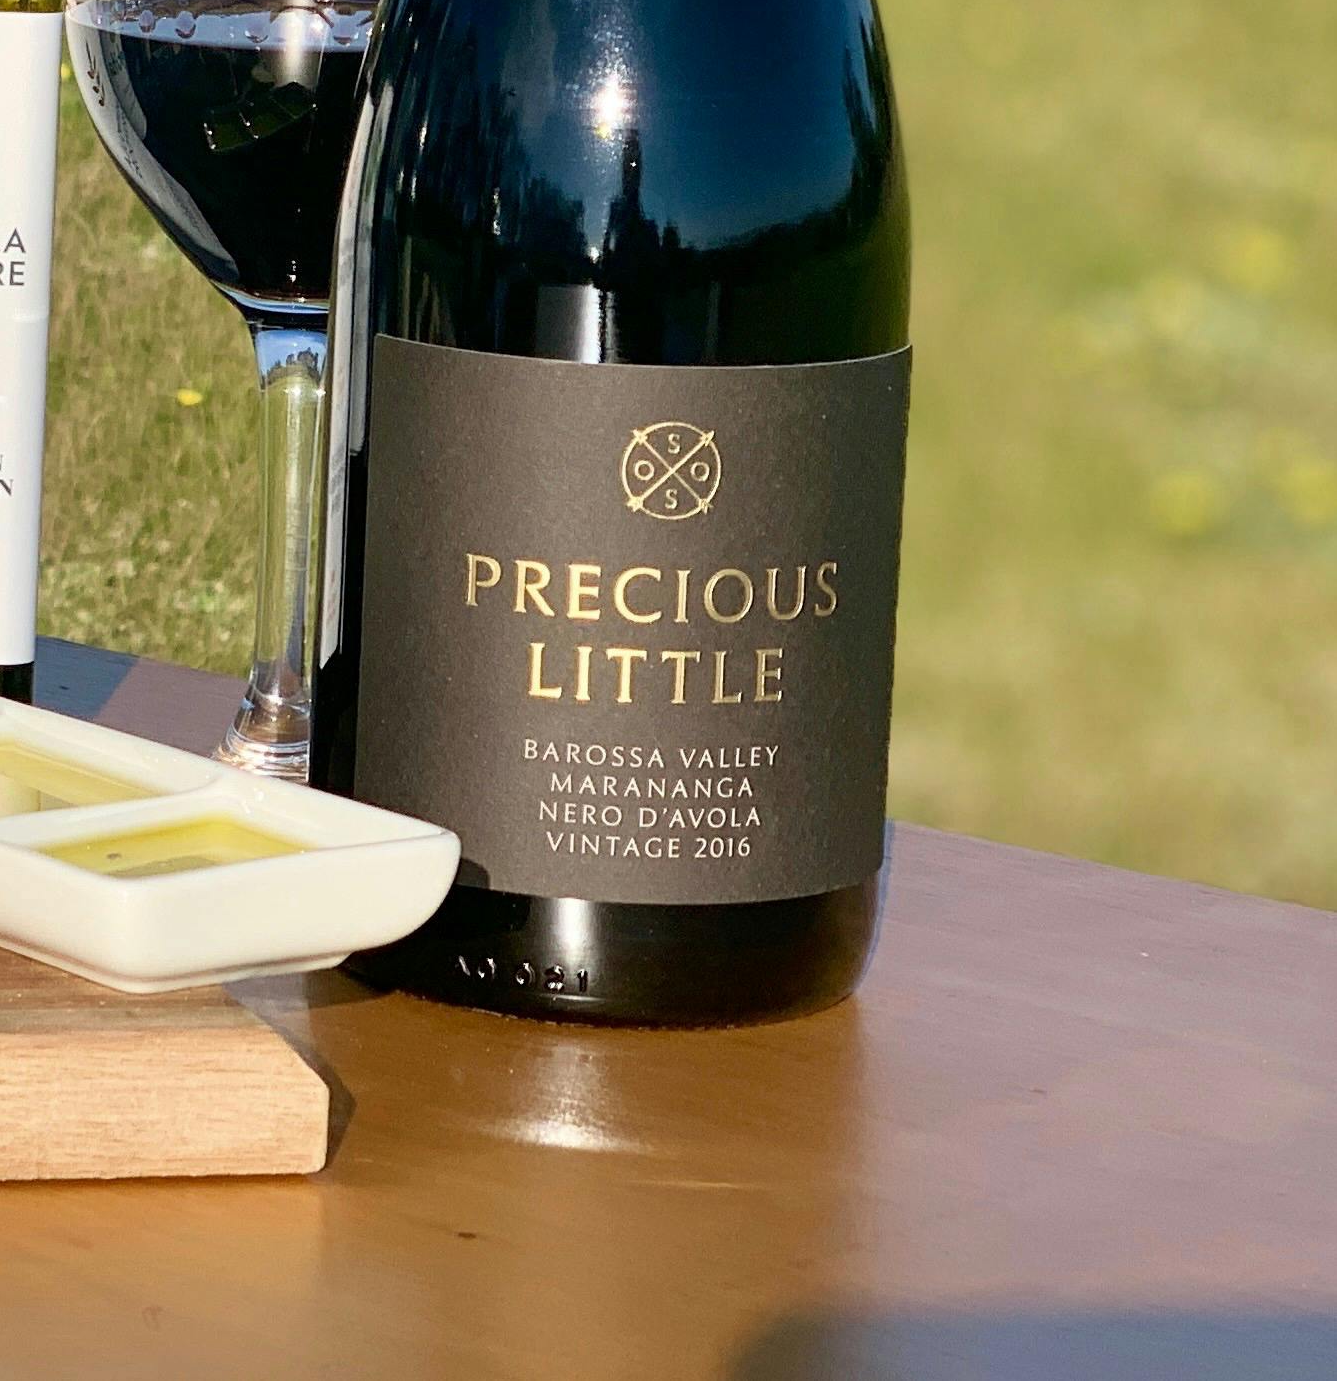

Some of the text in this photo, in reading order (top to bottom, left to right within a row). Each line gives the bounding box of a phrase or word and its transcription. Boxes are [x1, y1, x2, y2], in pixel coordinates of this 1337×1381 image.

[464, 552, 839, 625] PRECIOUS
[526, 641, 785, 706] LITTLE
[523, 738, 780, 769] BAROSSA VALLEY
[550, 773, 754, 799] MARANANGA
[539, 801, 761, 828] NERO D'AVOLA
[546, 830, 752, 860] VINTAGE 2016
